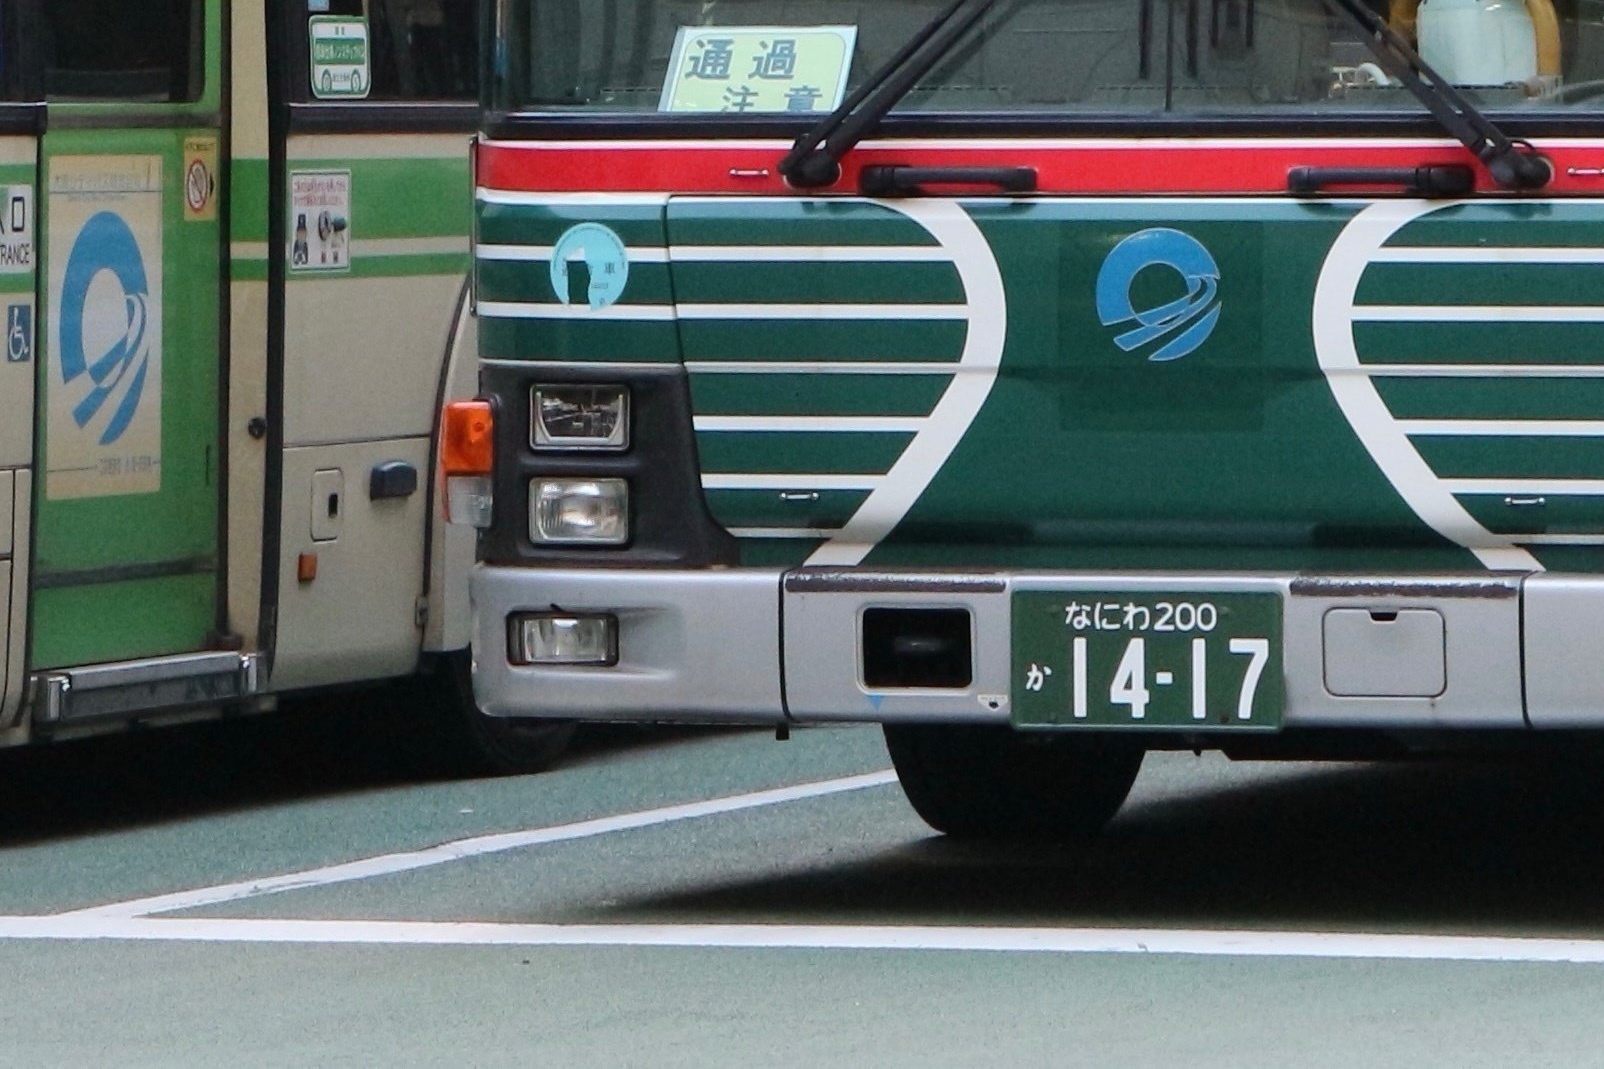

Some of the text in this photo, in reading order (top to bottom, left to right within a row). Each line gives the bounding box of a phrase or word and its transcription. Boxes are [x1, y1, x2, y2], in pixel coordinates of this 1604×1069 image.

[685, 38, 797, 80] 通過
[1025, 636, 1270, 720] か 14-17
